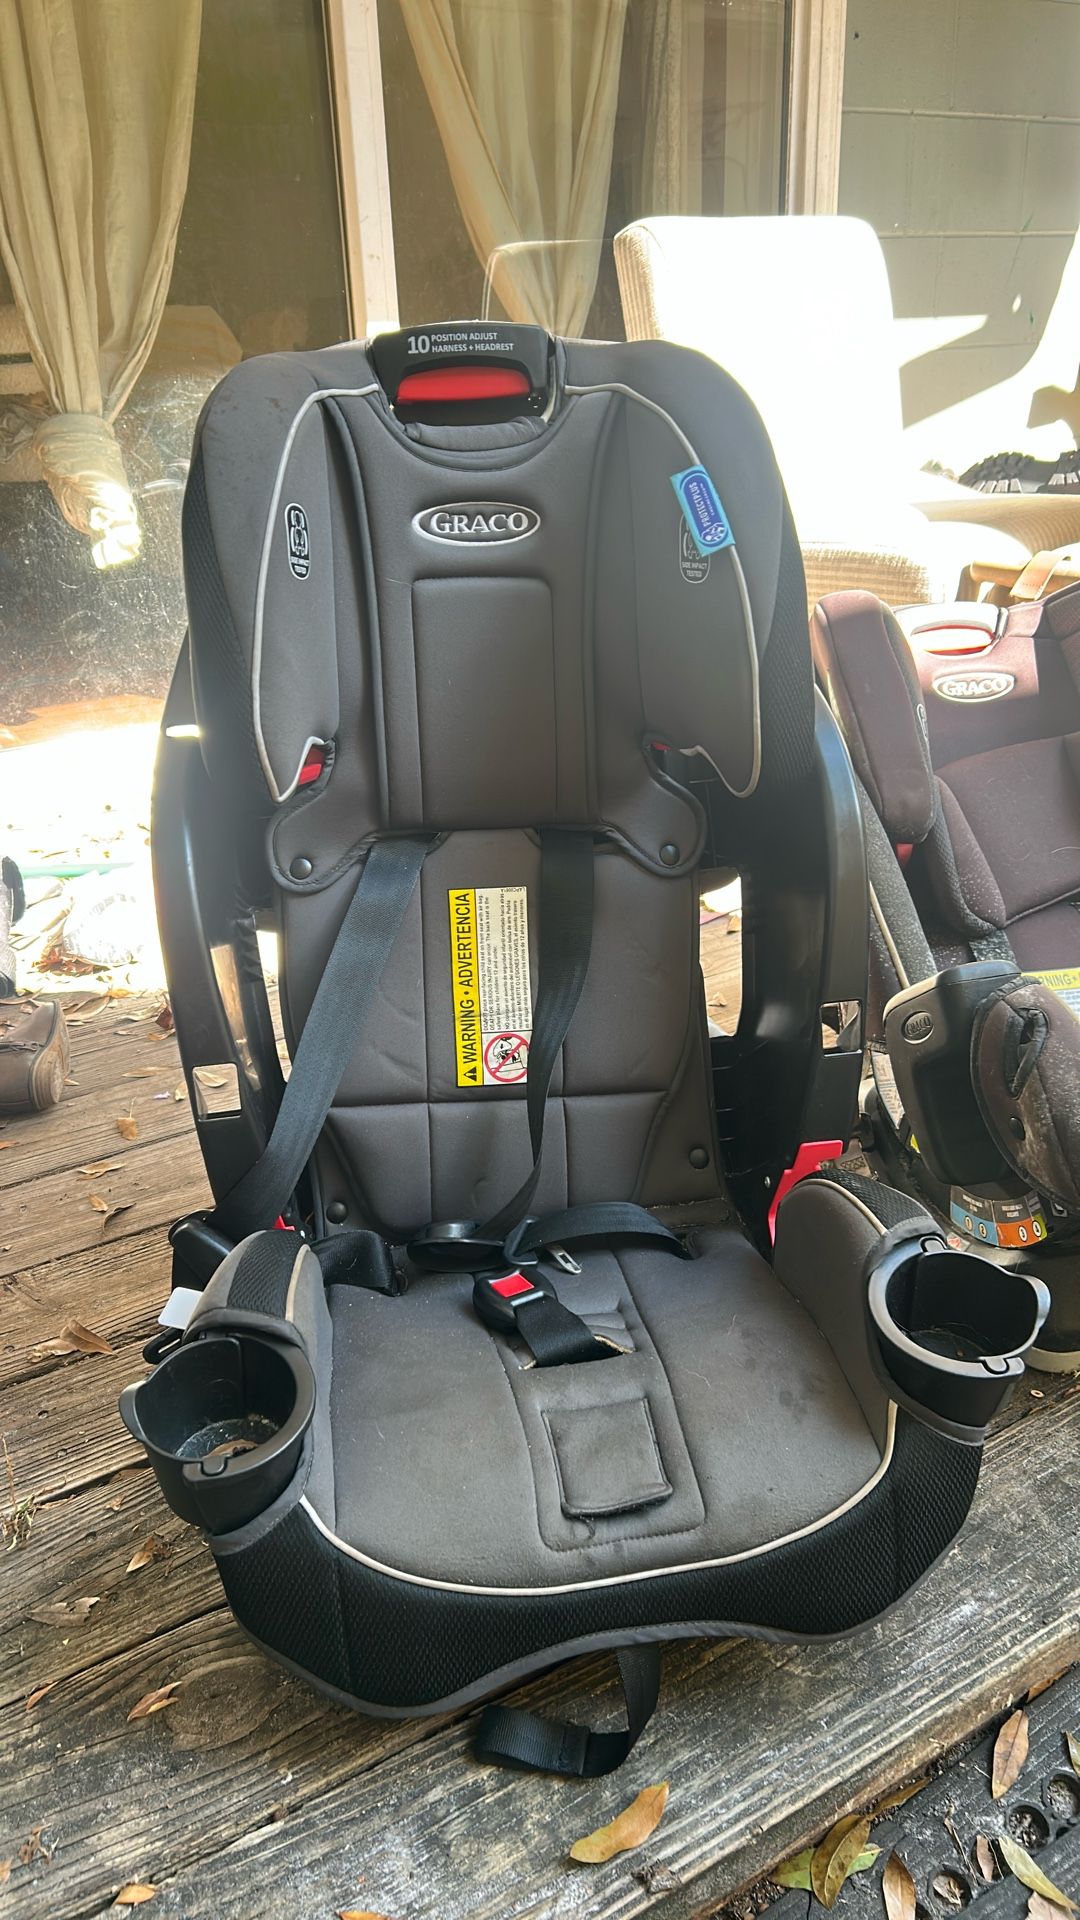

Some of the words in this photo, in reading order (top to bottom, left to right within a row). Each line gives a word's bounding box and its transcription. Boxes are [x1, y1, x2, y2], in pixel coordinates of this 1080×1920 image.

[408, 335, 430, 354] 10
[431, 333, 468, 342] POSITION
[432, 344, 467, 352] HARNESS
[475, 343, 514, 351] HEADREST
[688, 482, 712, 527] PROTECTPLUS
[430, 512, 528, 534] GRACO
[942, 678, 1008, 696] GRACO
[455, 893, 473, 987] ADVERTENCIA
[460, 1000, 477, 1064] WARNING
